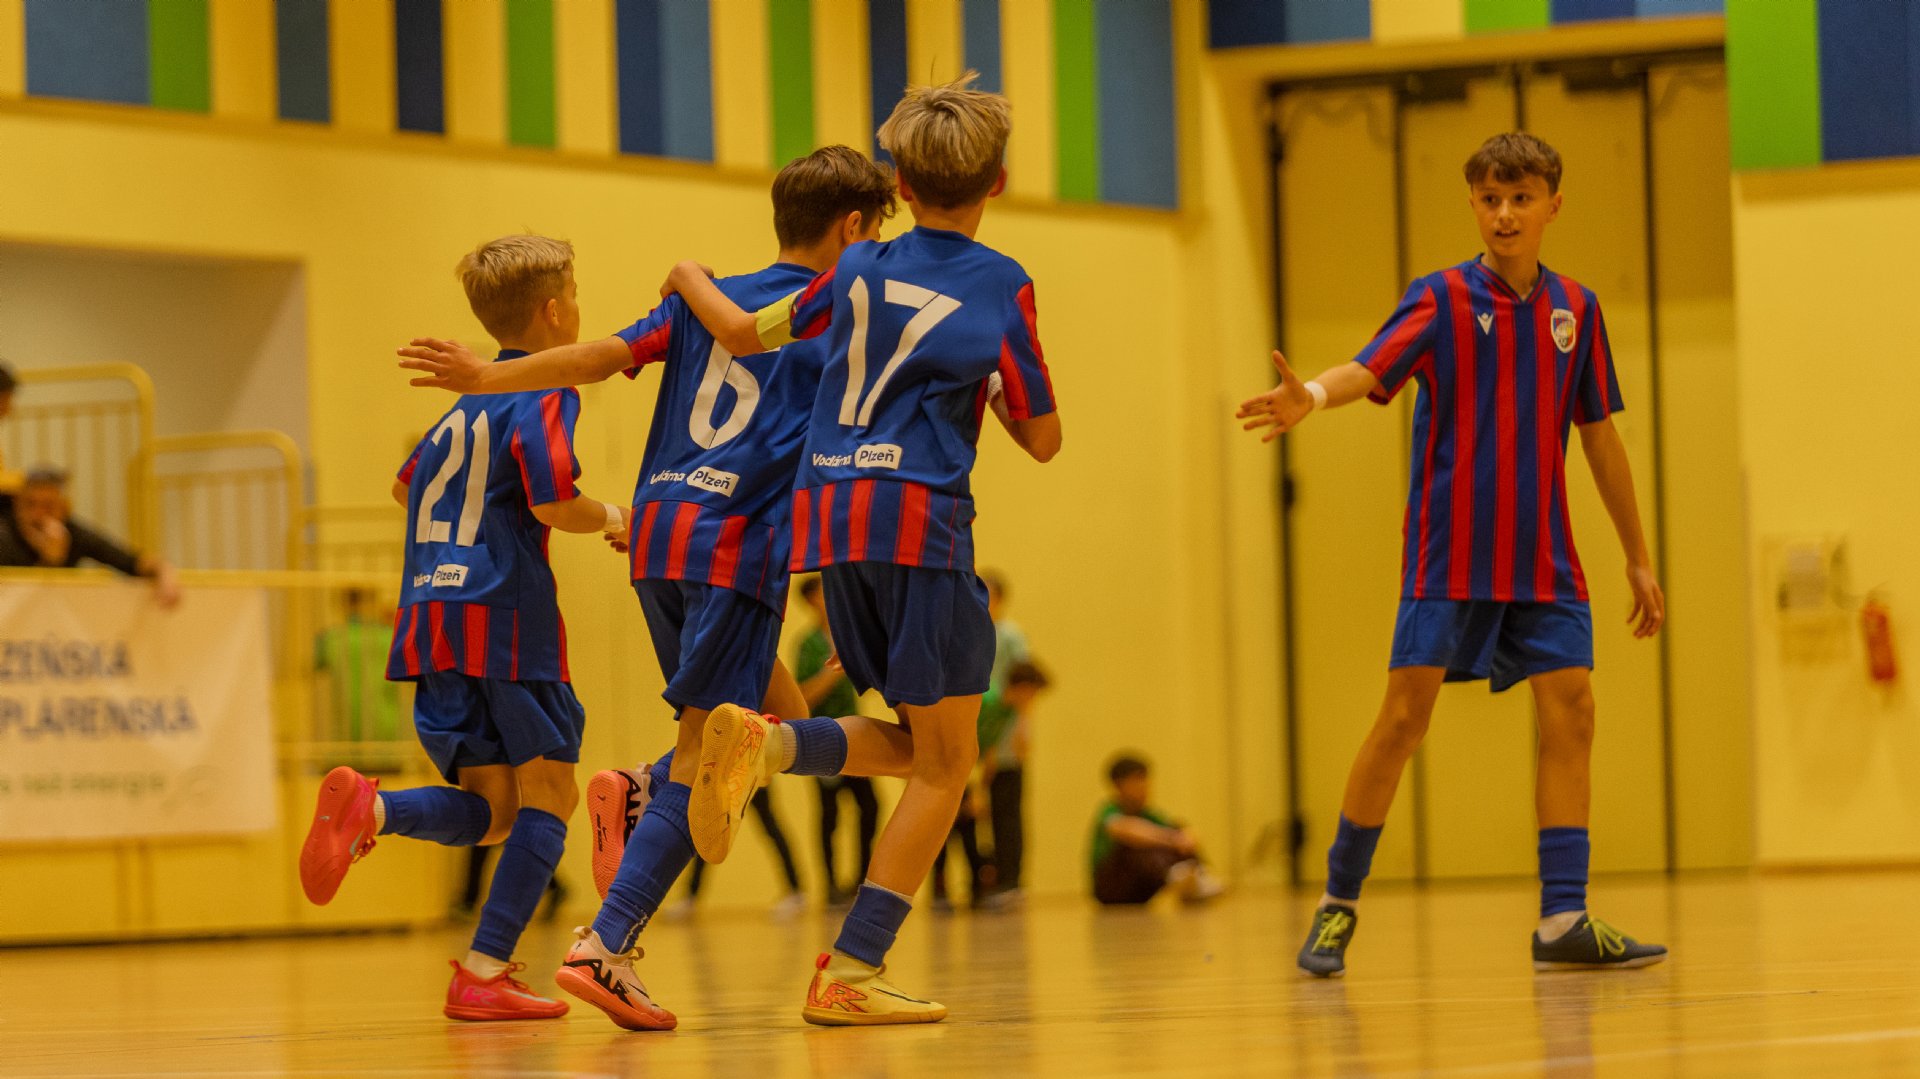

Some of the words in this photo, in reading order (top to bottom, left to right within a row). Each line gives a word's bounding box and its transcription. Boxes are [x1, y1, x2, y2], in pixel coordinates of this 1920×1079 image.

[838, 275, 962, 427] 17
[688, 337, 781, 450] 6
[415, 408, 490, 547] 21
[693, 470, 731, 489] Plzeň
[859, 448, 895, 463] Plzeň
[435, 569, 461, 581] Plzeň
